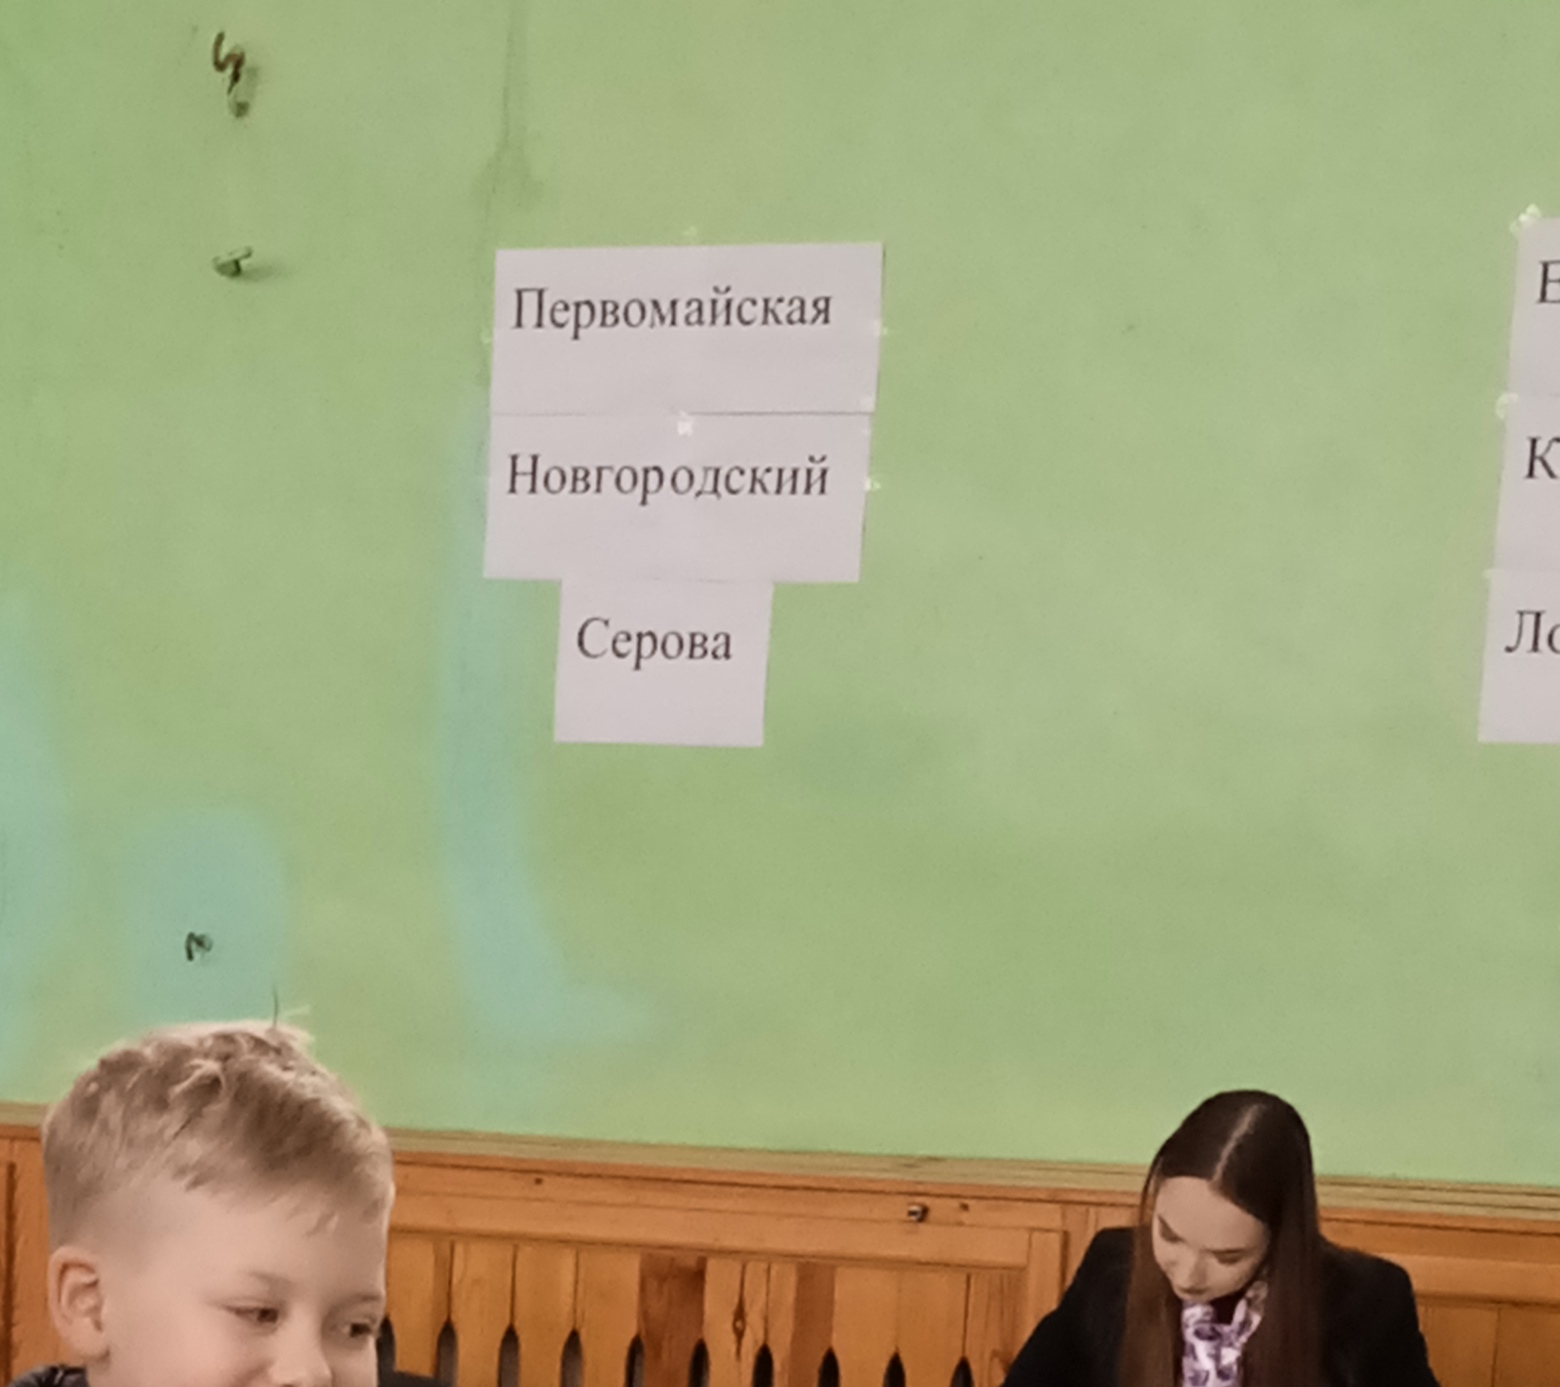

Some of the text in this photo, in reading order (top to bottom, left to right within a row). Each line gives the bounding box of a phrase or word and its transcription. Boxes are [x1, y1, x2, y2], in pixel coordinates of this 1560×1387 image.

[512, 285, 832, 340] Первомайская
[506, 454, 829, 506] Новгородский
[576, 616, 733, 671] Серова
